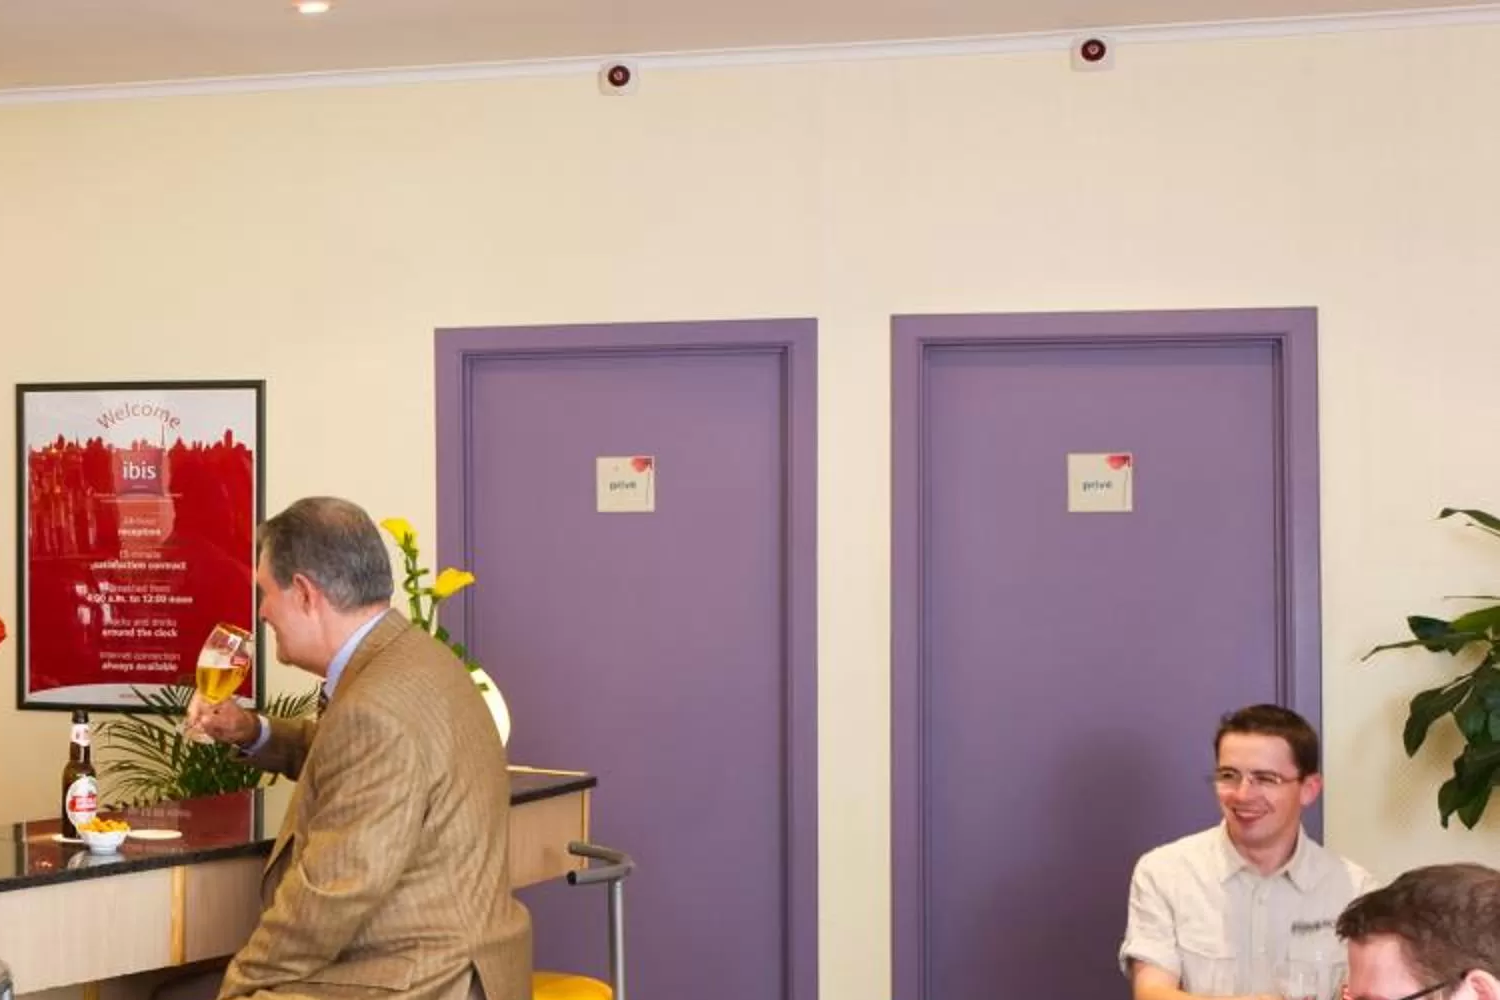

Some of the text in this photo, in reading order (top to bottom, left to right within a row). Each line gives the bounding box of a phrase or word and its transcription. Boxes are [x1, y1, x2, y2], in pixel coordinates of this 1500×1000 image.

[96, 402, 181, 429] Welcome
[123, 460, 157, 480] ibis
[102, 628, 179, 637] around the clock
[102, 662, 179, 672] always available
